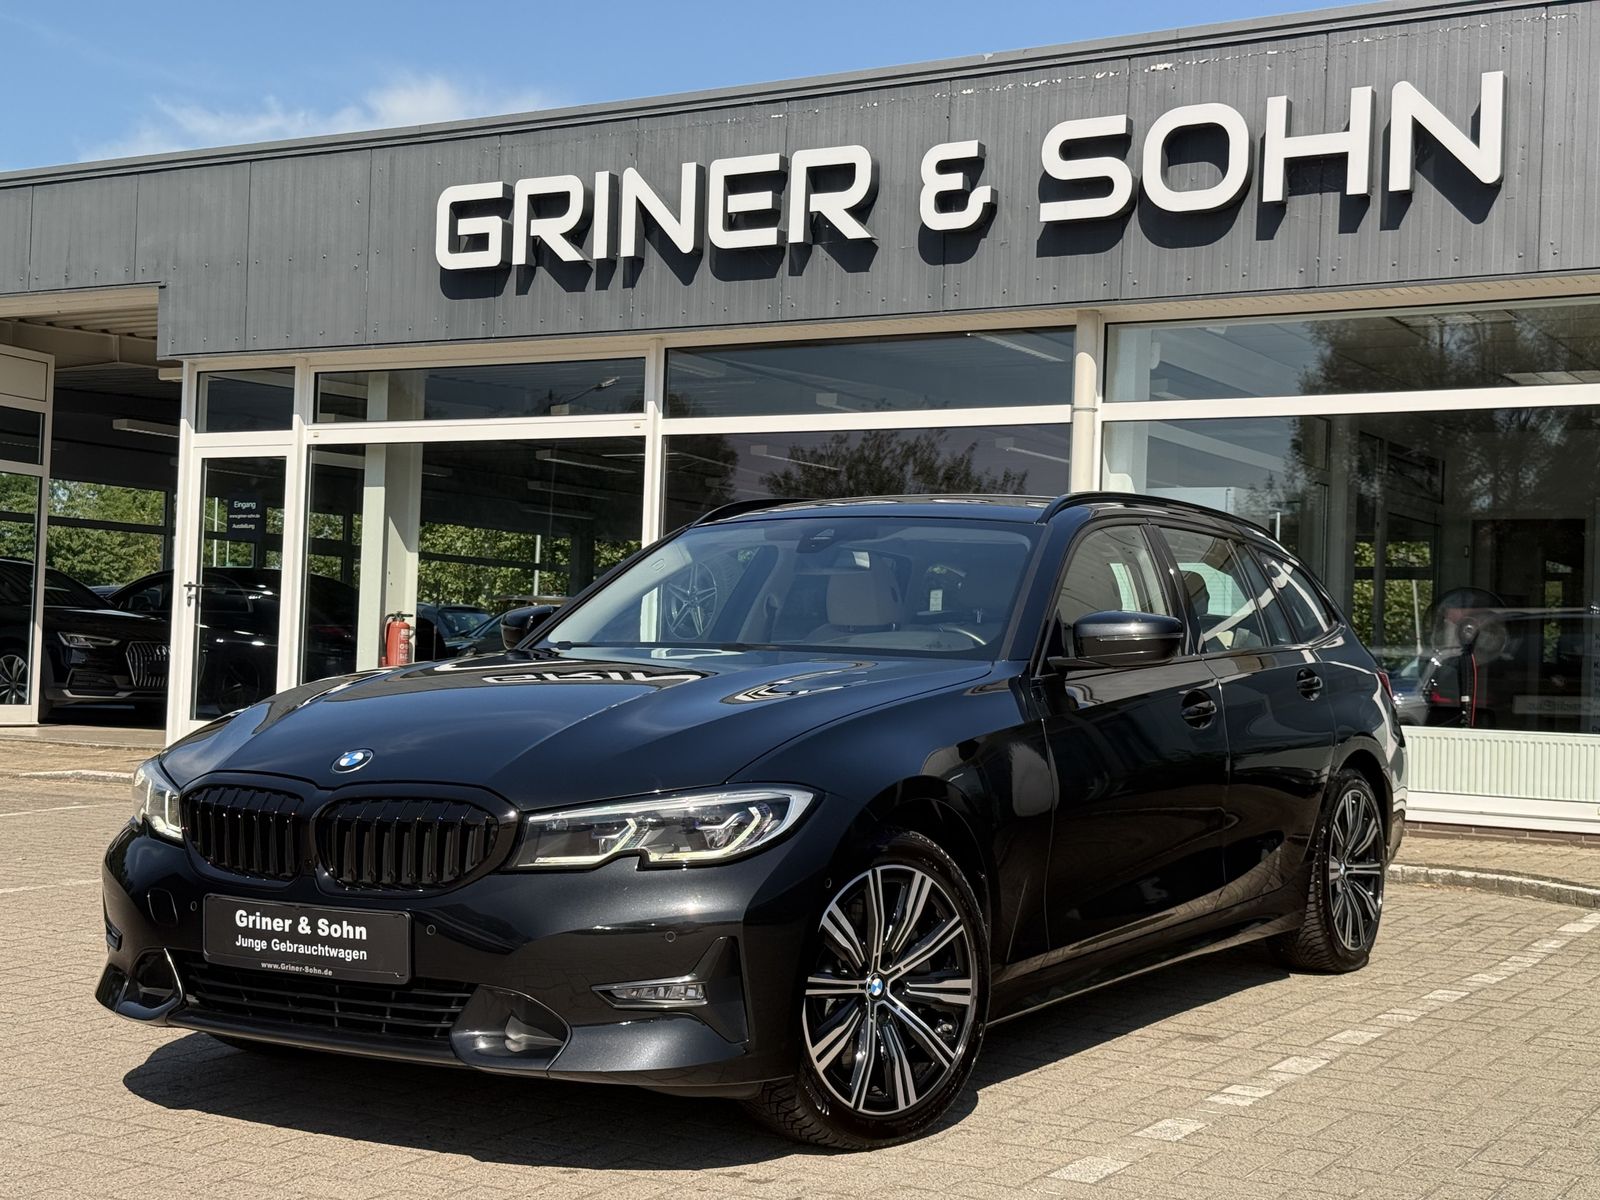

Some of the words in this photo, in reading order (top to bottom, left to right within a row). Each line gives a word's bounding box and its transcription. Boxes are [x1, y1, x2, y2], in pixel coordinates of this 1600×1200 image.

[435, 144, 874, 270] GRINER
[919, 139, 992, 231] &
[1039, 70, 1505, 222] SOHN
[233, 500, 256, 509] Eingang
[235, 909, 293, 932] Griner
[297, 916, 312, 935] &
[317, 918, 367, 940] Sohn
[235, 934, 268, 951] Junge
[271, 938, 367, 961] Gebrauchtwagen
[260, 962, 333, 976] www.Griner-Sohn.de
